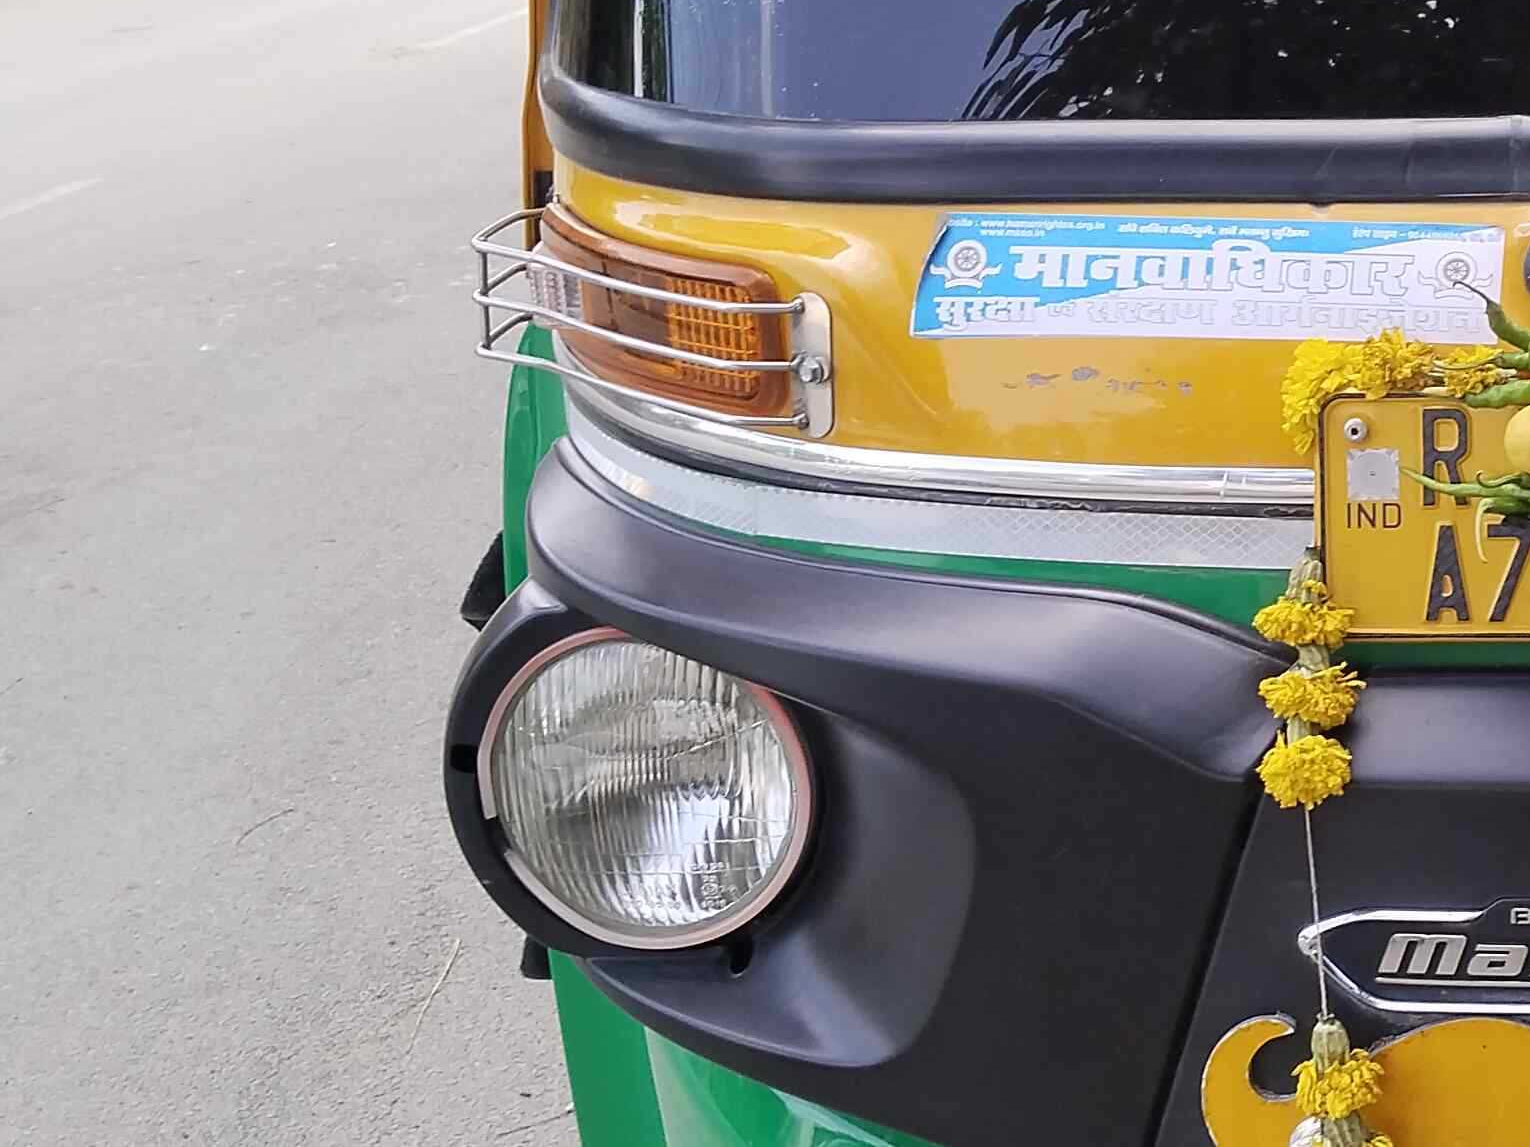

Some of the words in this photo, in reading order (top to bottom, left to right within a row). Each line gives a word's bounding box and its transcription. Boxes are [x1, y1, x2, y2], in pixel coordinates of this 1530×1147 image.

[1010, 239, 1415, 296] मानवाधिकार
[933, 296, 1041, 332] सुरक्षा
[1347, 502, 1402, 529] IND
